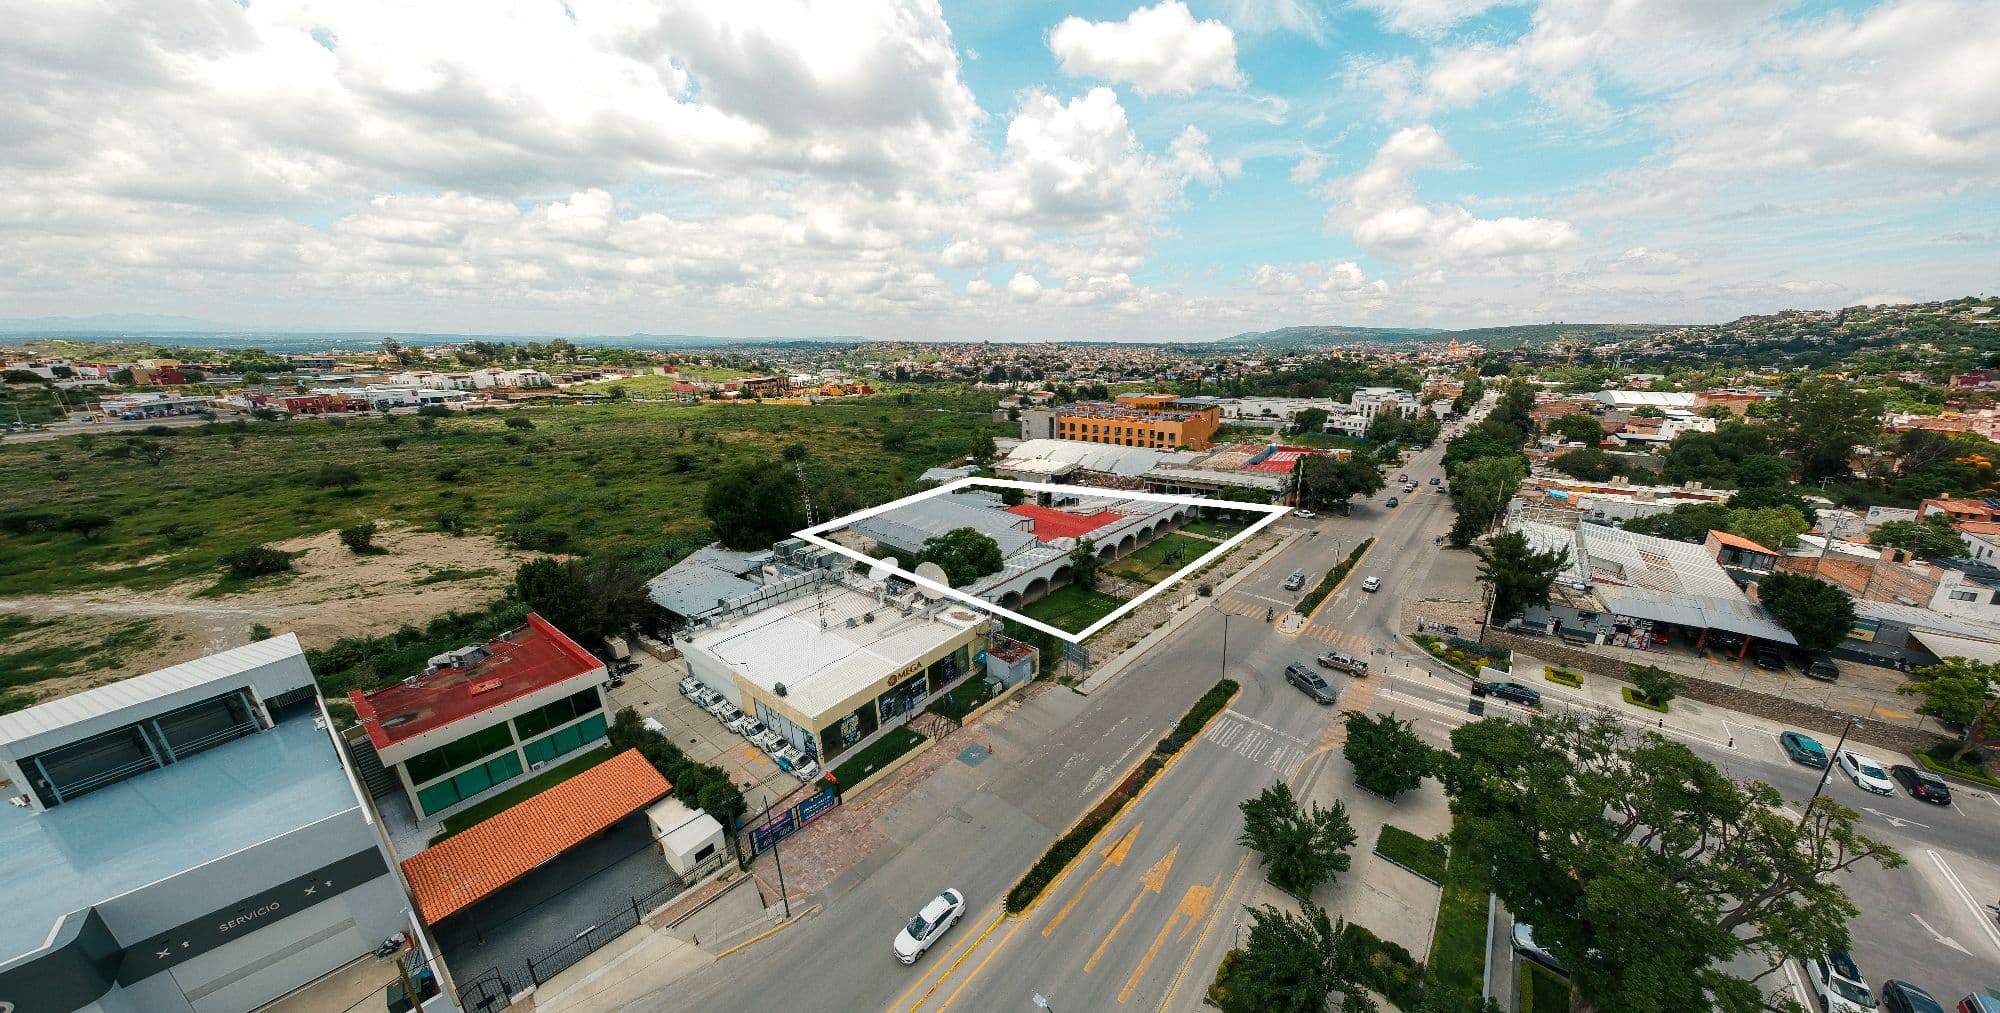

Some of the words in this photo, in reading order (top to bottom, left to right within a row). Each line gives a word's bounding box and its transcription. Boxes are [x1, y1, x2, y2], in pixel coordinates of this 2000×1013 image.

[897, 661, 922, 681] MEGA
[1203, 717, 1244, 748] ALTO
[218, 902, 280, 933] SERVICIO
